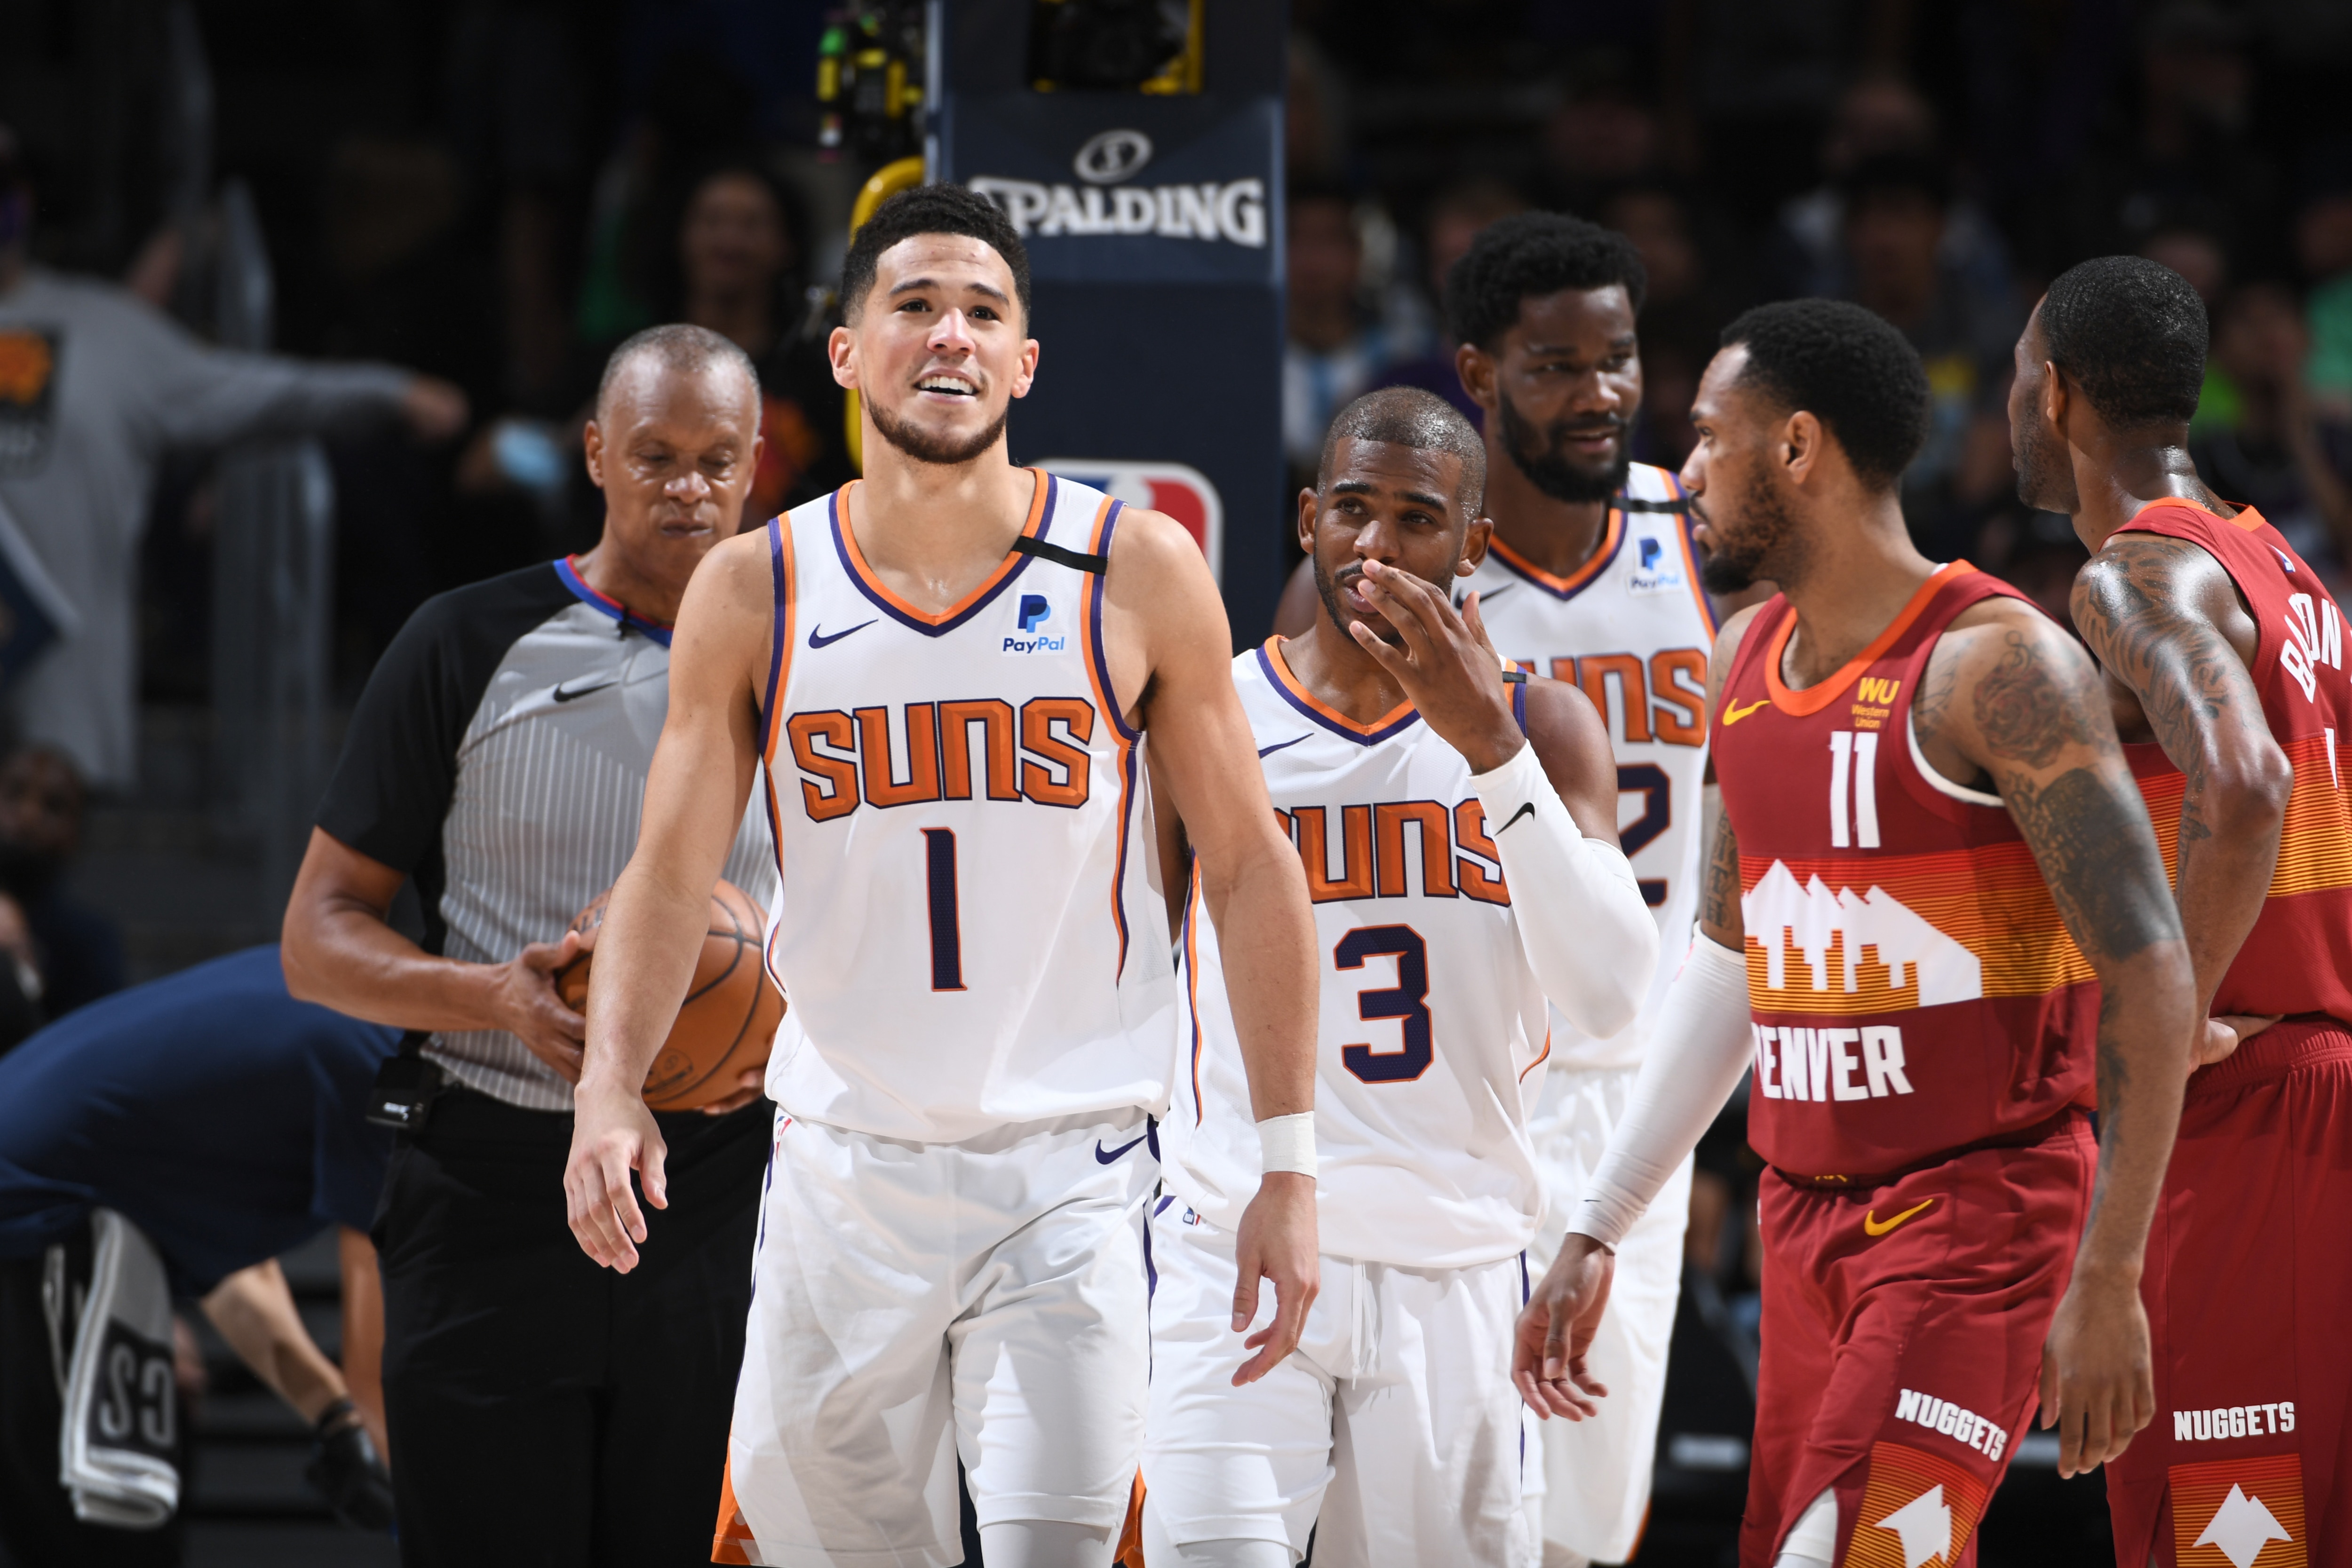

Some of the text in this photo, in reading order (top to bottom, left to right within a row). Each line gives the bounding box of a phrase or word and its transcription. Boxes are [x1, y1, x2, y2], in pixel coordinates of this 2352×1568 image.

[1003, 636, 1065, 654] PayPal
[1851, 704, 1890, 718] Western
[1855, 716, 1881, 729] Union
[1858, 677, 1901, 705] WU
[786, 697, 1096, 823] SUNS
[1829, 731, 1880, 848] 11
[1273, 798, 1512, 908] UNS
[919, 826, 968, 992] 1
[1333, 923, 1434, 1085] 3
[1894, 1388, 2008, 1462] NUGGETS
[2173, 1401, 2295, 1441] NUGGETS
